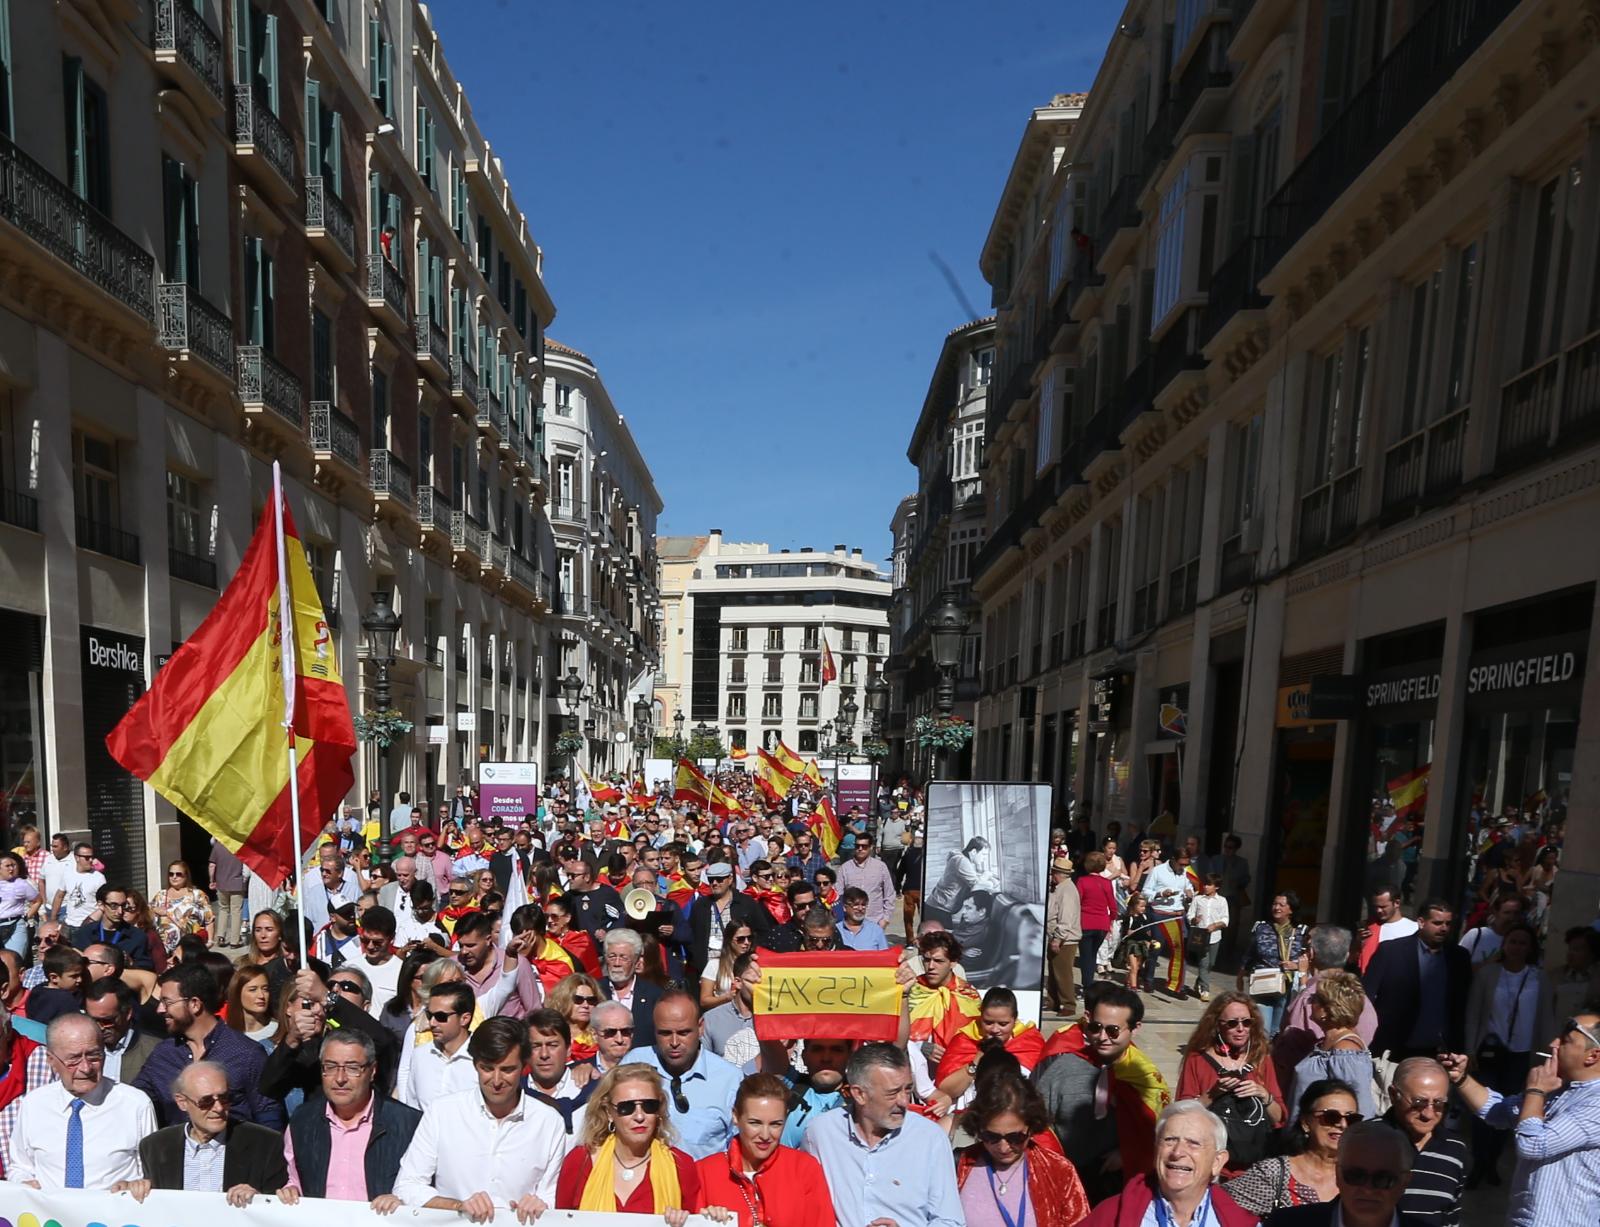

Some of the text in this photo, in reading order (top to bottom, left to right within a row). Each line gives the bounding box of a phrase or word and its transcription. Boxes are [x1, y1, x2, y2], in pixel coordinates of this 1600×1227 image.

[89, 637, 138, 671] Bershka
[1468, 652, 1575, 693] SPRINGFIELD
[1366, 674, 1441, 706] SPRINGFIELD
[491, 804, 524, 813] CORAZÓN
[493, 796, 514, 804] Desde
